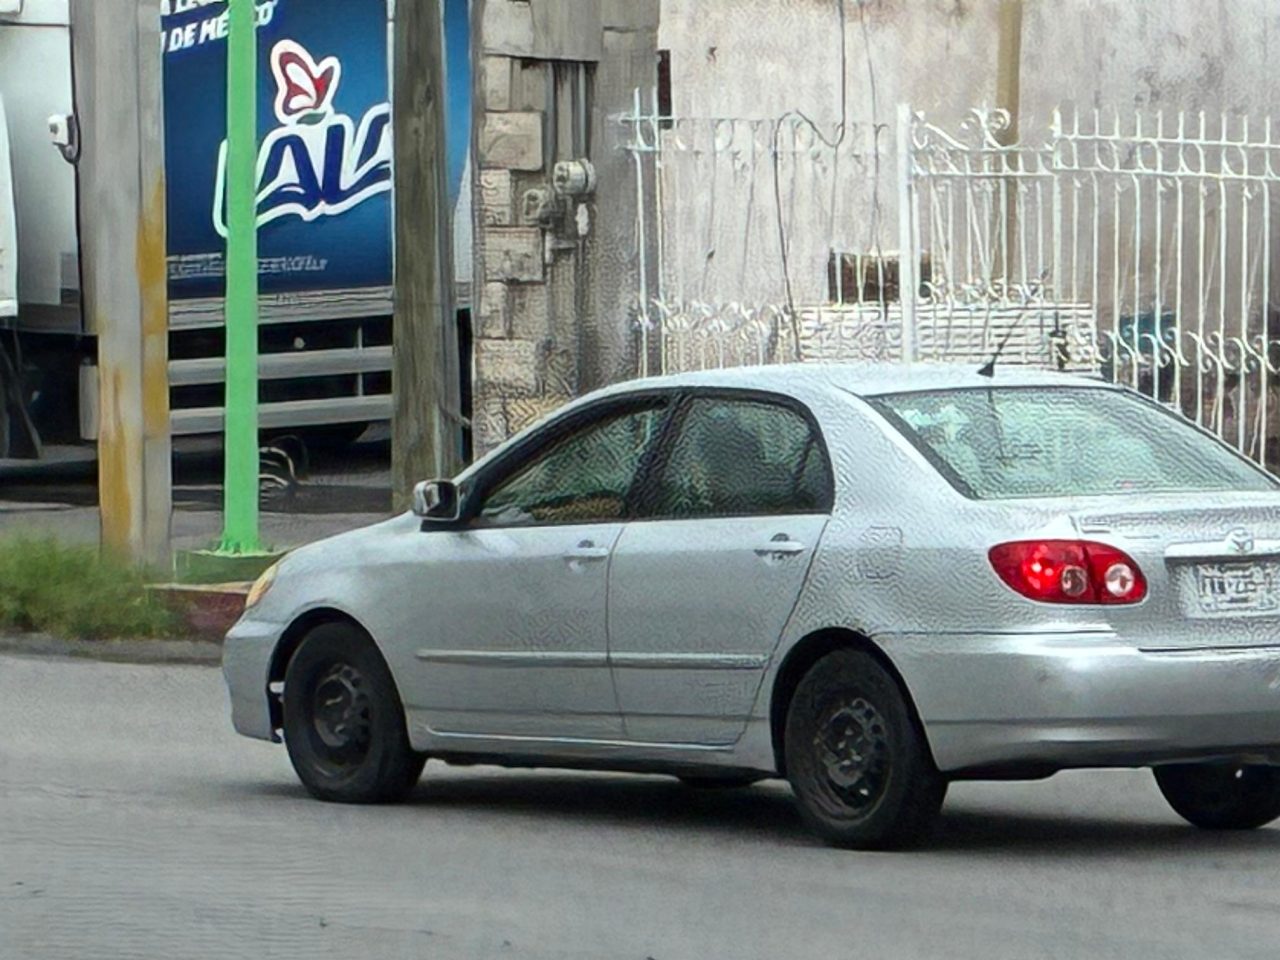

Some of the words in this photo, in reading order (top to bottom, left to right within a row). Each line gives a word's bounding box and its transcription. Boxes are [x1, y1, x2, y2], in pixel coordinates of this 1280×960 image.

[167, 22, 198, 52] DE
[198, 6, 275, 44] MÉO
[213, 102, 393, 257] AL
